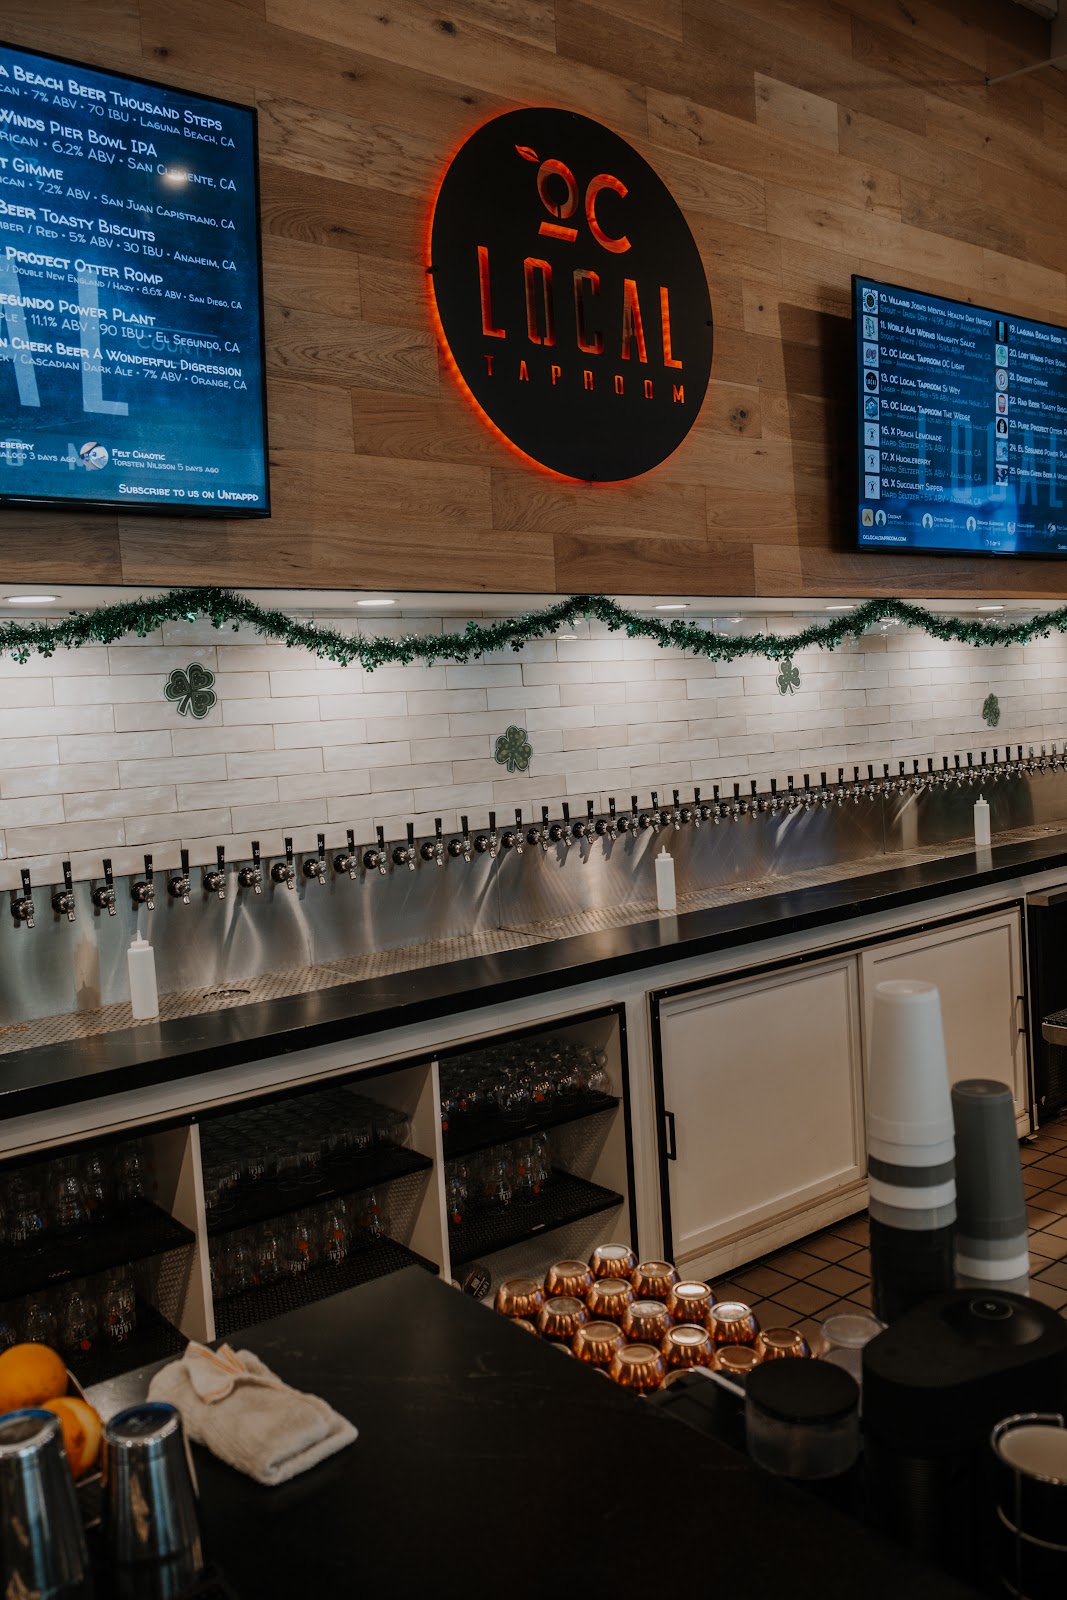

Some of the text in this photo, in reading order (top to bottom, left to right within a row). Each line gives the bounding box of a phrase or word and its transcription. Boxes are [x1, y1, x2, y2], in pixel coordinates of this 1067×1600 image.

[537, 158, 632, 253] OC
[477, 245, 683, 370] LOCAL
[484, 355, 685, 404] TAPROOM
